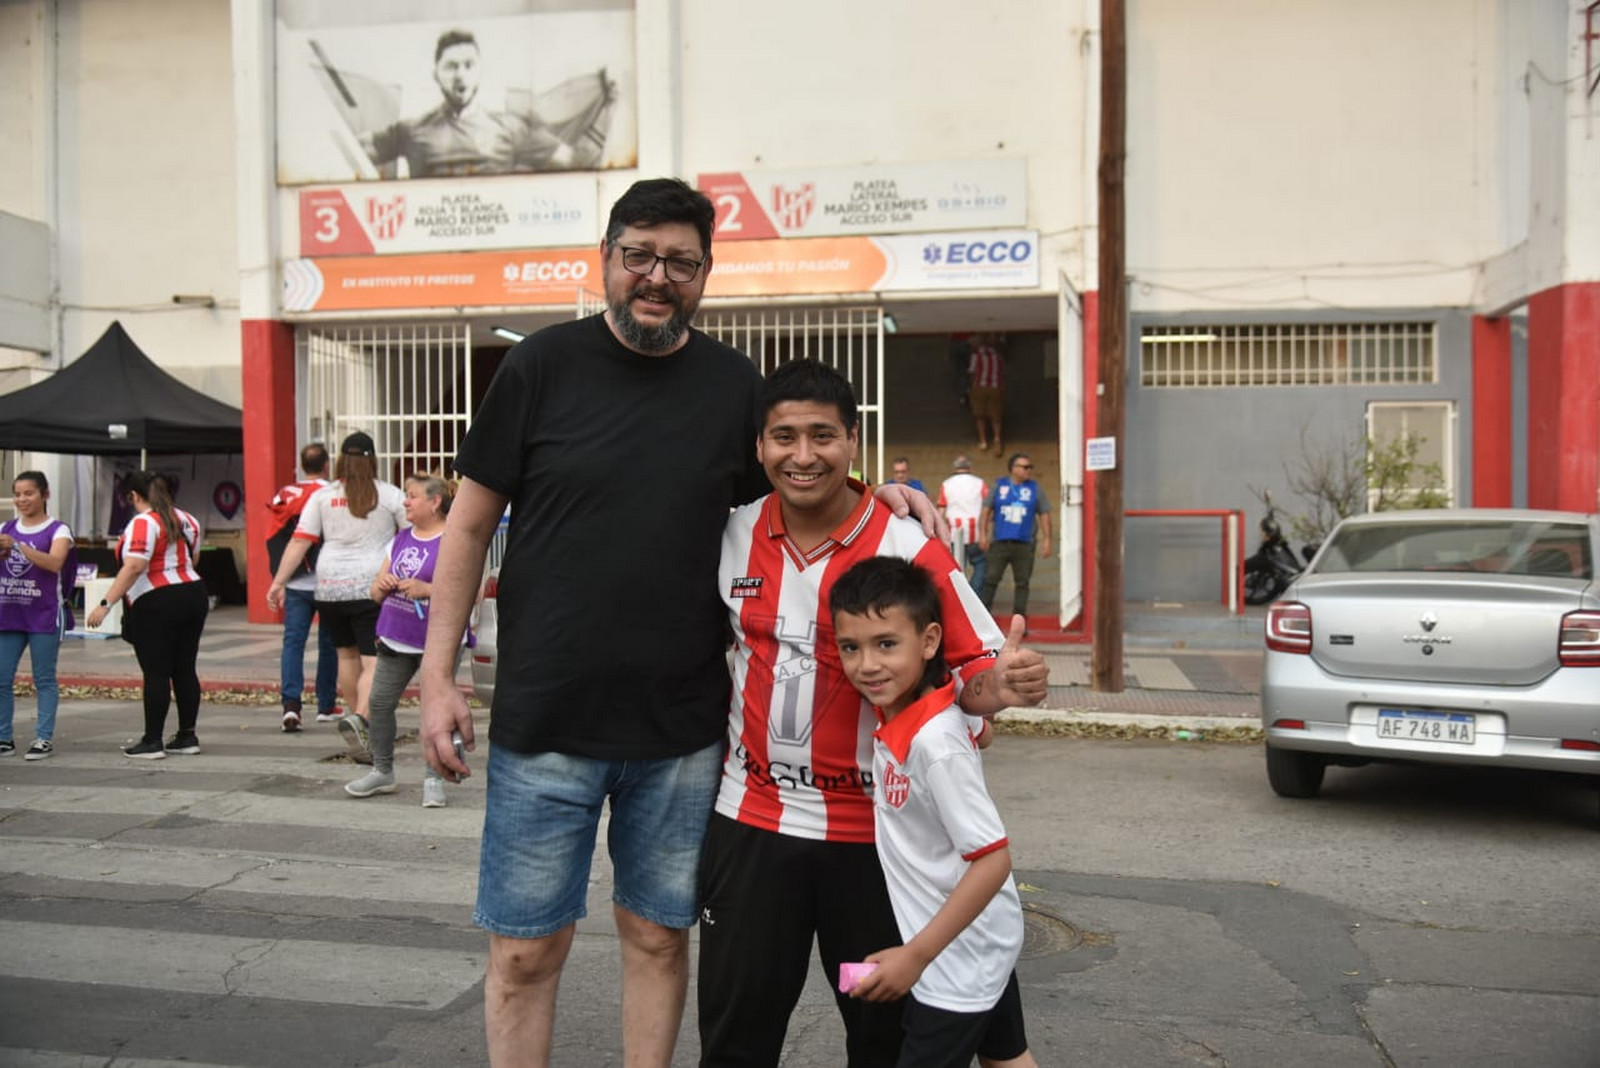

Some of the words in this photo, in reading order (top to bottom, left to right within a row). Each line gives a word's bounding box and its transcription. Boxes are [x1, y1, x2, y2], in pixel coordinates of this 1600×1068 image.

[853, 179, 897, 191] PLATEA
[441, 194, 481, 205] PLATEA
[850, 190, 899, 201] LATERAL
[418, 206, 447, 216] ROJA
[460, 202, 505, 213] BLANCA
[717, 194, 742, 232] 2
[823, 203, 871, 215] MARIO
[874, 198, 928, 212] KEMPES
[315, 207, 341, 243] 3
[414, 214, 457, 227] MARIO
[460, 212, 509, 225] KEMPES
[840, 215, 888, 226] ACCESO
[890, 212, 914, 223] SUR
[429, 227, 473, 238] ACCESO
[475, 225, 496, 236] SUR
[946, 240, 1031, 264] ECCO
[521, 260, 588, 282] ECCO
[712, 262, 775, 275] UIDAMOS
[778, 260, 794, 273] TU
[1382, 719, 1404, 736] AF
[1409, 720, 1442, 739] 748
[1447, 722, 1470, 741] WA
